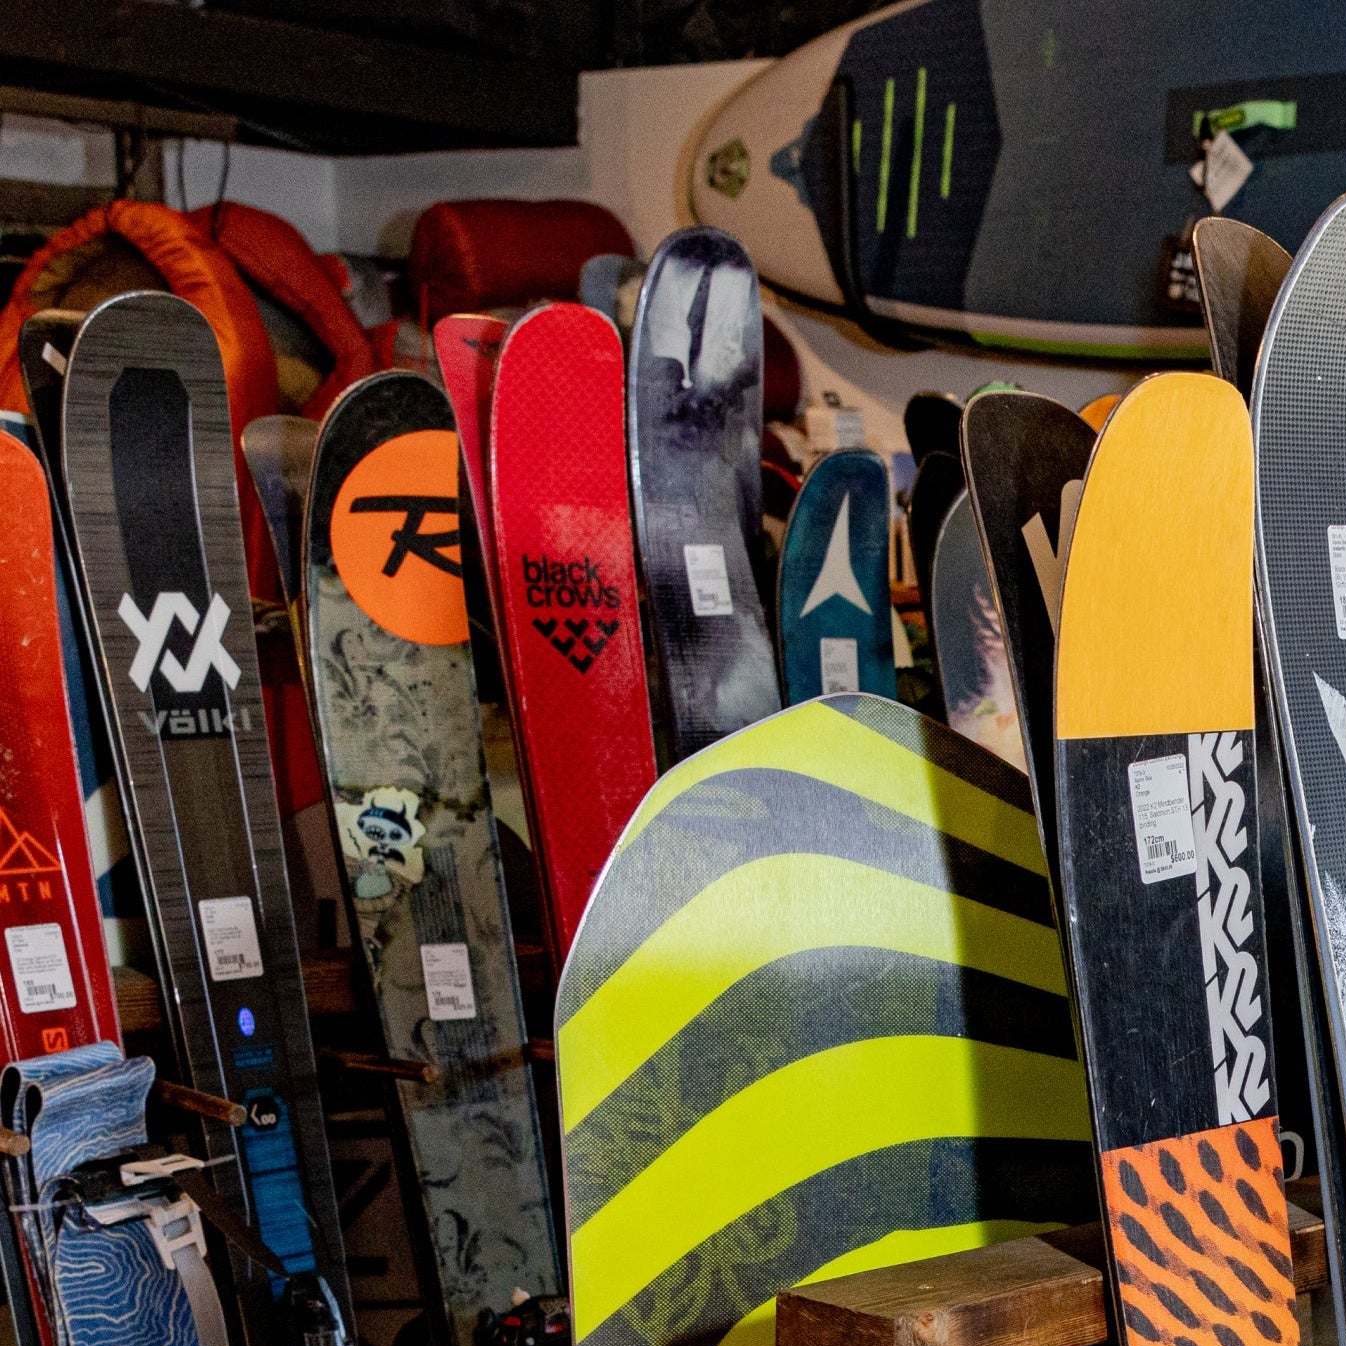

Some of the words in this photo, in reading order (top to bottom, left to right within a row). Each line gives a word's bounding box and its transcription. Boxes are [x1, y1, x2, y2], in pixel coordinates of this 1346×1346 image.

[522, 553, 601, 585] black
[526, 583, 622, 609] crows
[136, 706, 251, 736] Völkl
[1144, 835, 1164, 846] 172cm
[1170, 850, 1195, 864] $600.00
